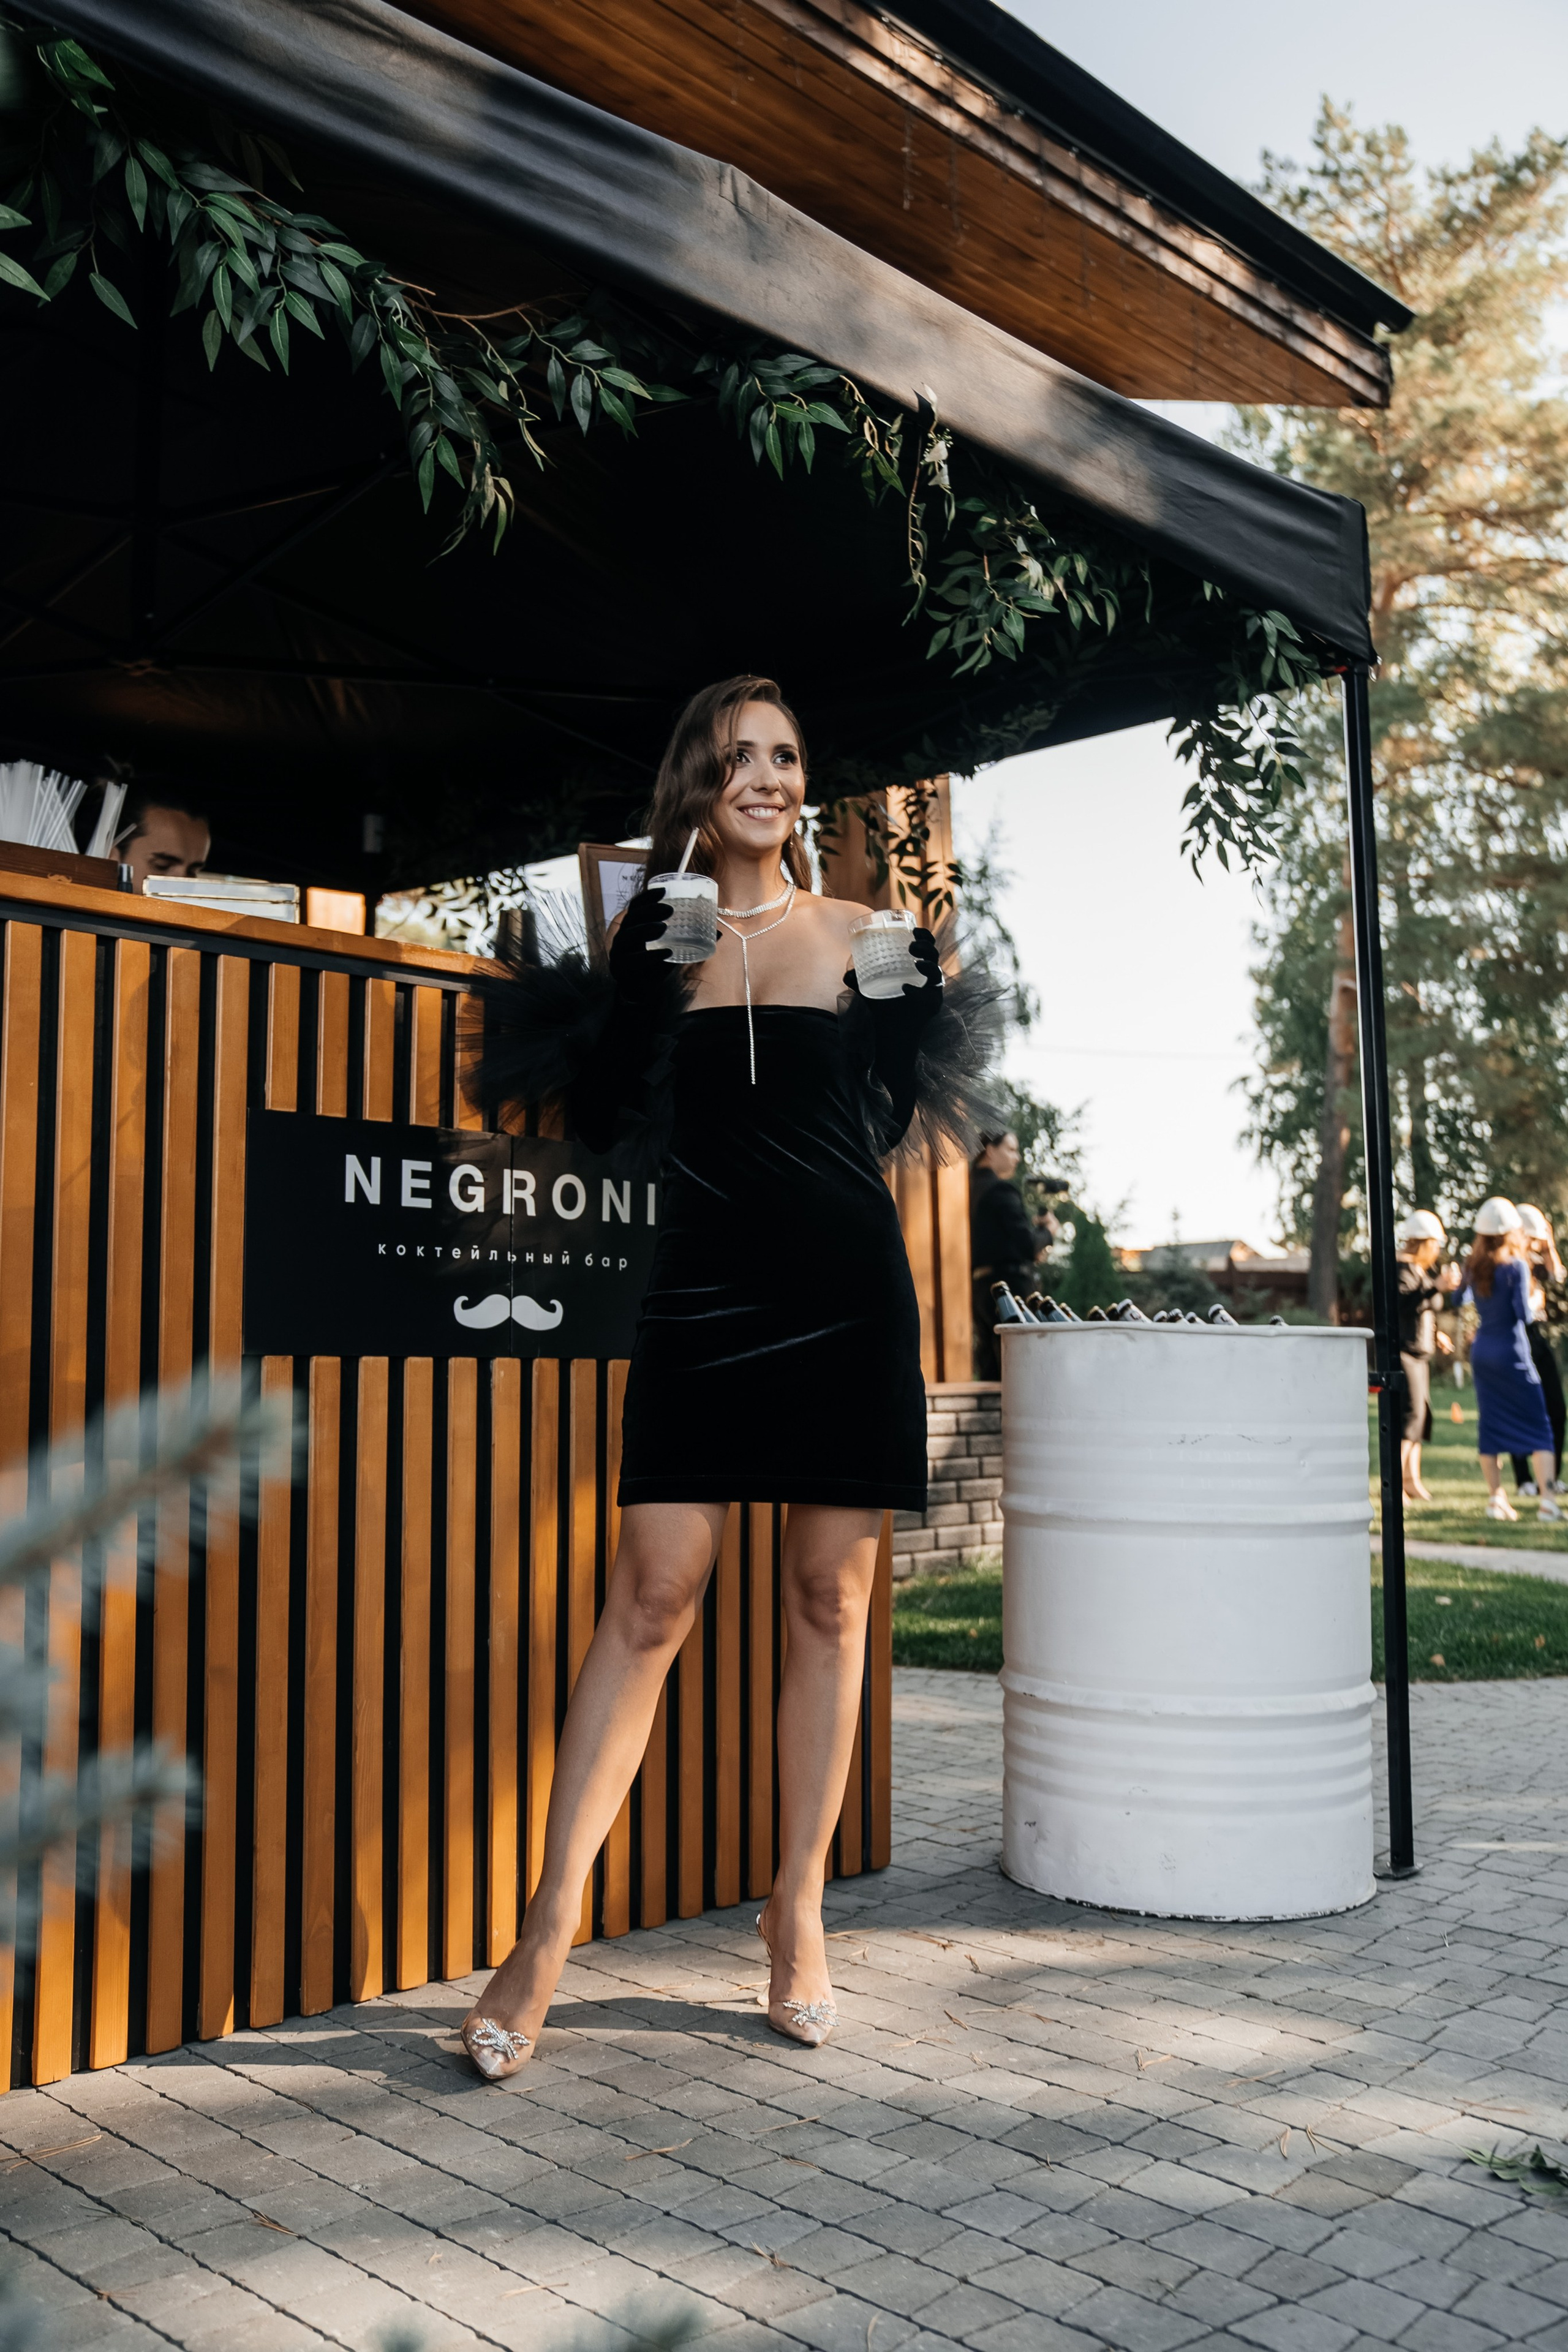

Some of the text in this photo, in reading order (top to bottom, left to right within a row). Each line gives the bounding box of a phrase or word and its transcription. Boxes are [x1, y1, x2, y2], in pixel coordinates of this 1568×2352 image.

[345, 1154, 656, 1226] NEGRONI
[377, 1243, 628, 1271] коктейльный бар
